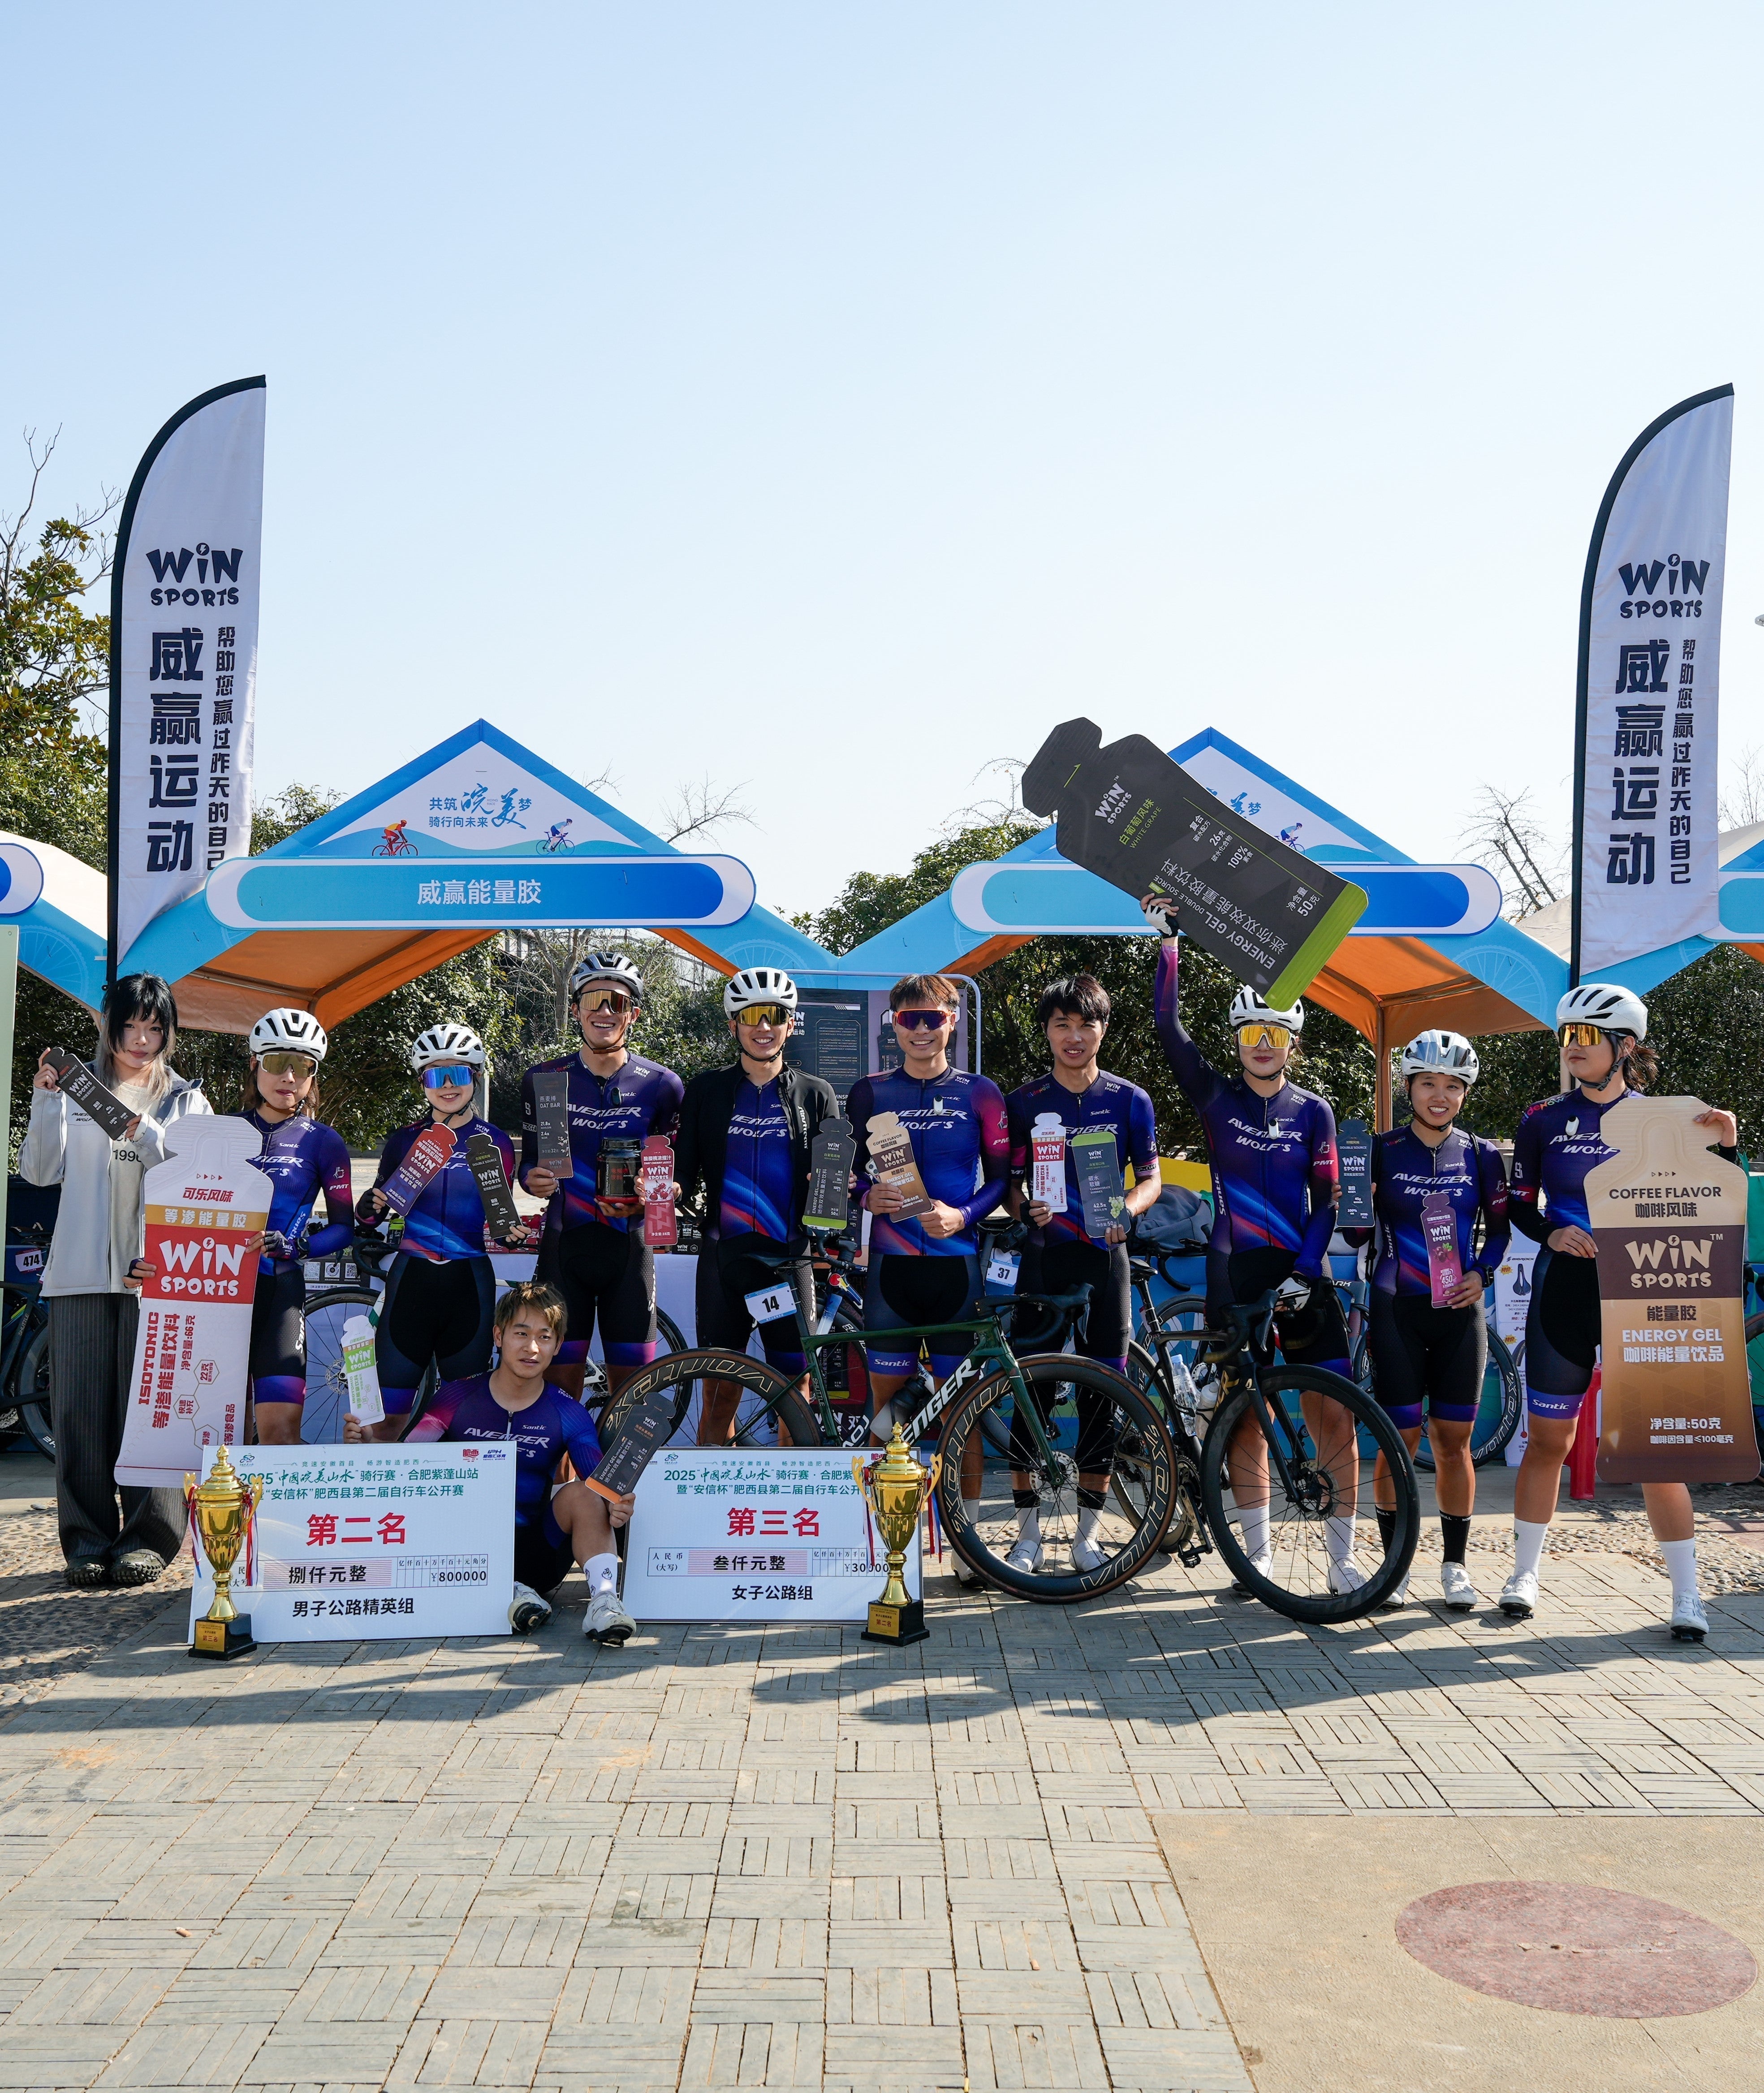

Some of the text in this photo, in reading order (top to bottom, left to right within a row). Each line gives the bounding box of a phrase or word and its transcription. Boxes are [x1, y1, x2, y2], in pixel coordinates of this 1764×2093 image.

[151, 587, 239, 606] SPORTS
[1620, 600, 1702, 618] SPORTS
[147, 627, 203, 872] 威赢运动
[207, 626, 236, 870] 帮助您赢过昨天的自己
[1607, 639, 1670, 885] 威赢运动
[1670, 639, 1696, 884] 帮助您赢过昨天的自己
[1107, 792, 1132, 824] SPORTS
[429, 816, 488, 828] 骑行向未来
[1119, 798, 1154, 845] 白葡萄风味
[1130, 806, 1162, 848] WHITE GRAPE
[1189, 814, 1204, 831] 复合
[1192, 820, 1211, 842] 碳水配方
[1209, 829, 1225, 846] 26克
[1211, 835, 1233, 862] 碳水化合物
[1228, 845, 1248, 869] 100%
[417, 879, 541, 905] 威赢能量胶
[1286, 886, 1309, 912] 净含量
[1160, 858, 1288, 955] 迷你双效能量胶饮料
[1298, 895, 1320, 917] 50克
[1153, 874, 1276, 969] ENERGY GEL DOUBLE SOURCE
[76, 1081, 92, 1098] SPORTS
[572, 1118, 629, 1129] WOLF'S
[728, 1126, 787, 1137] WOLF'S
[1235, 1136, 1291, 1152] WOLF'S
[410, 1157, 430, 1174] SPORTS
[885, 1158, 906, 1168] SPORTS
[399, 1167, 423, 1187] ENERGY GEL
[482, 1178, 501, 1186] SPORTS
[887, 1174, 904, 1183] ENERGY
[1392, 1173, 1473, 1186] AVENGER
[182, 1186, 233, 1203] 可乐风味
[1609, 1187, 1721, 1199] COFFEE FLAVOR
[164, 1207, 247, 1228] 等渗能量胶
[1635, 1202, 1697, 1218] 咖啡风味
[23, 1254, 39, 1267] 474
[998, 1267, 1010, 1280] 37
[1630, 1272, 1712, 1288] SPORTS
[160, 1276, 239, 1298] SPORTS
[762, 1296, 780, 1313] 14
[1647, 1305, 1697, 1321] 能量胶
[1622, 1329, 1723, 1343] ENERGY GEL
[138, 1312, 159, 1405] ISOTONIC
[874, 1358, 911, 1367] Santic
[1624, 1346, 1725, 1363] 咖啡能量饮品
[152, 1314, 180, 1429] 等渗能量饮料
[200, 1363, 209, 1381] 22克
[350, 1361, 371, 1370] SPORTS
[812, 1378, 824, 1406] SHUTTLE
[178, 1400, 186, 1414] 快速
[186, 1400, 194, 1414] 补充
[1532, 1399, 1569, 1410] Santic
[1650, 1417, 1721, 1430] 净含量:50克
[463, 1427, 550, 1448] AVENGER
[1650, 1434, 1734, 1444] 咖啡因含量≤100毫克
[599, 1463, 612, 1480] ENERGY
[677, 1484, 860, 1494] 暨“安信杯”肥西县第二届自行车公开
[306, 1512, 406, 1547] 第二名
[727, 1507, 820, 1537] 第三名
[653, 1552, 683, 1560] 人民币
[713, 1555, 786, 1571] 叁仟元整
[289, 1565, 366, 1584] 捌仟元整
[656, 1563, 677, 1572] (大写)
[732, 1585, 813, 1600] 女子公路组
[292, 1598, 414, 1617] 男子公路精英组
[876, 1619, 892, 1627] 第二名
